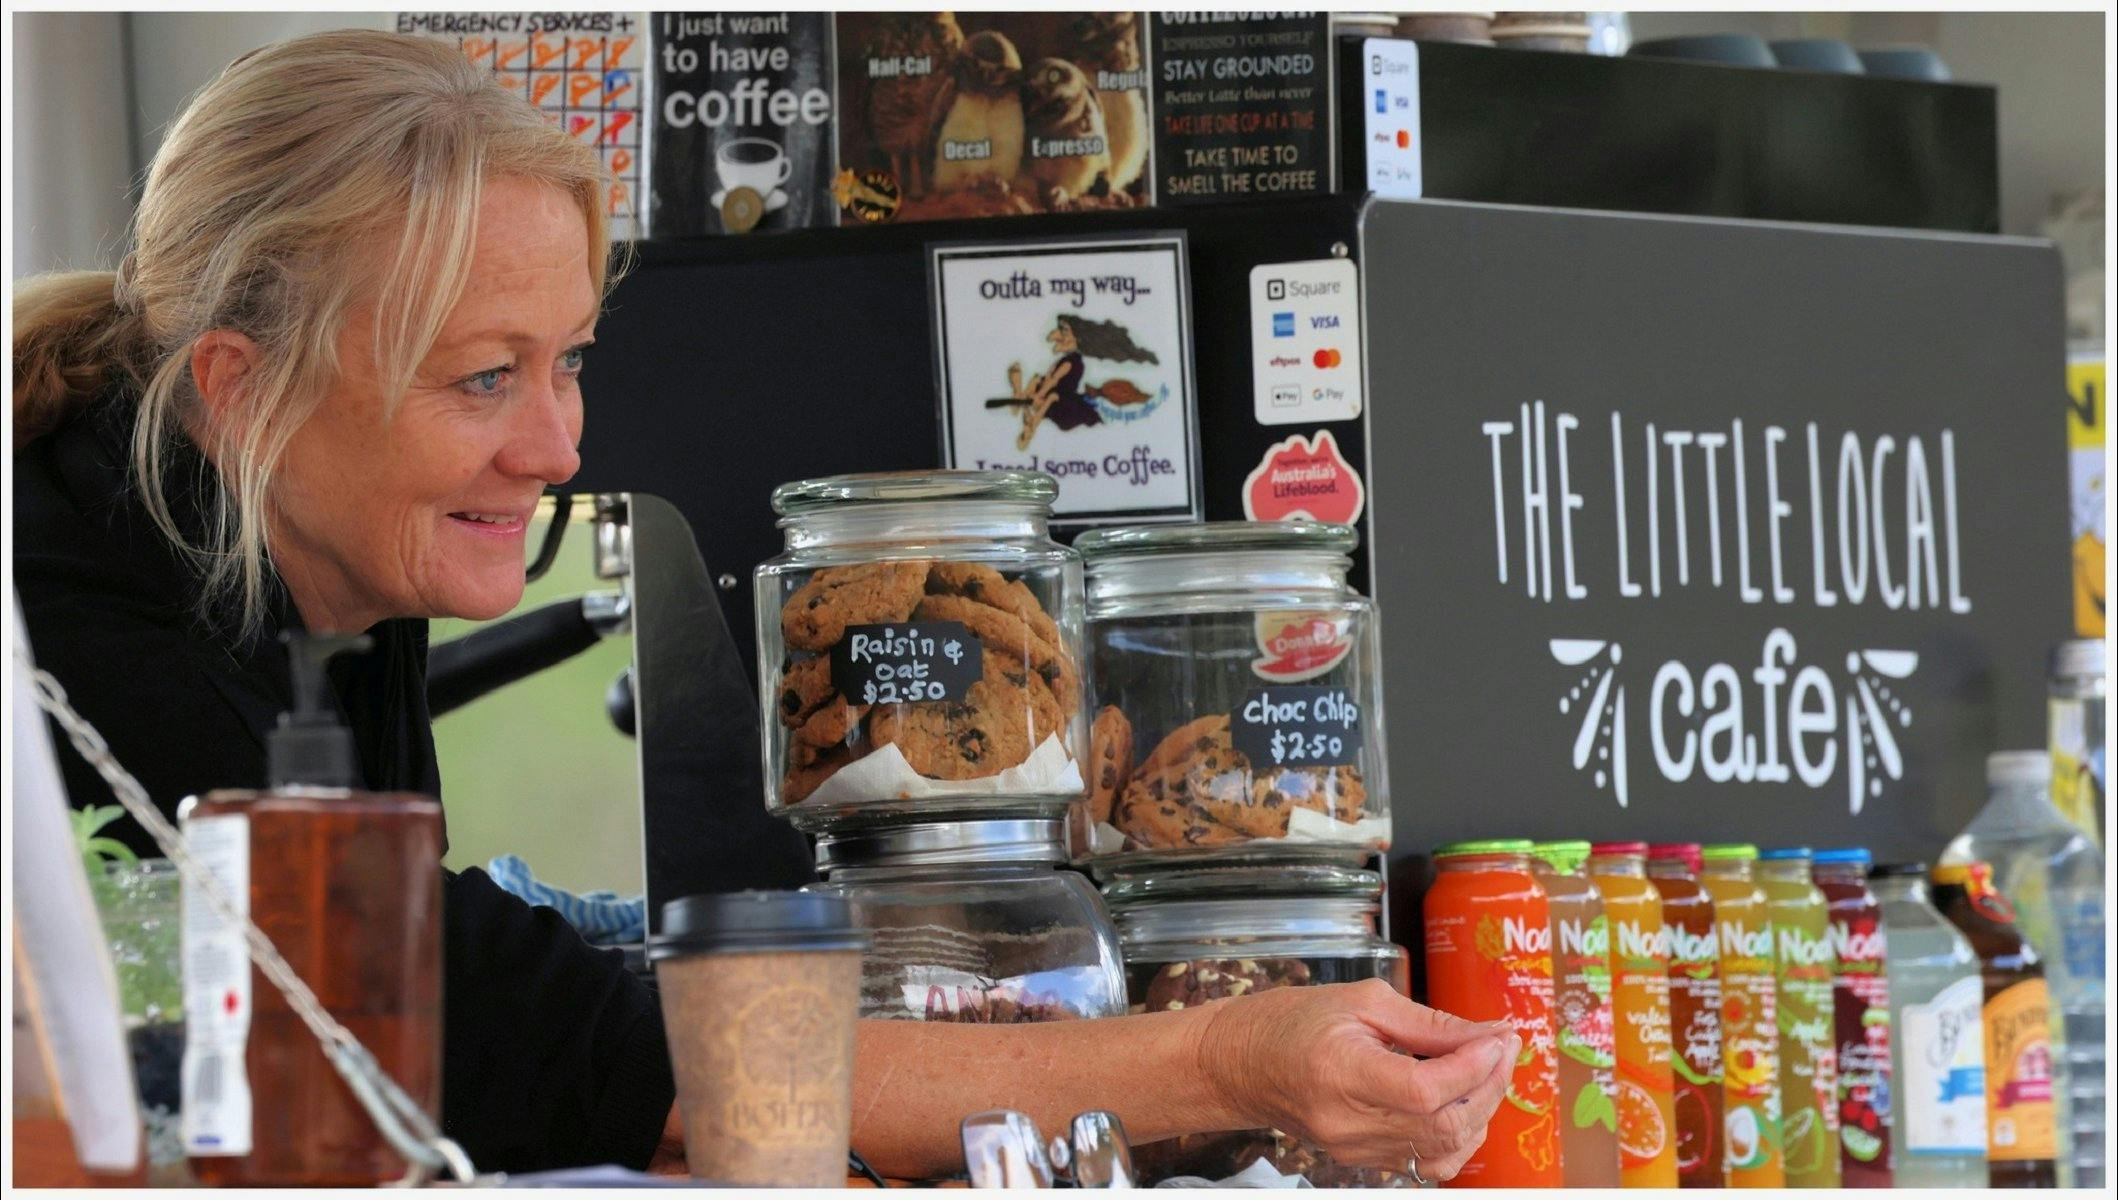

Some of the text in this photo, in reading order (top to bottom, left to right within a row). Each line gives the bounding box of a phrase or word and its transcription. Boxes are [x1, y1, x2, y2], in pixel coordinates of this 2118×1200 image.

[398, 12, 520, 33] EMERGENCY
[526, 11, 612, 33] SERVICES
[677, 12, 724, 40] just
[729, 13, 789, 35] want
[663, 40, 791, 73] to have
[1163, 53, 1315, 82] STAY GROUNDED
[663, 78, 831, 130] coffee
[1185, 144, 1299, 168] TAKE TIME TO
[1167, 170, 1317, 196] SMELL THE COFFEE
[1049, 278, 1085, 307] my
[1289, 280, 1341, 299] Square
[1310, 315, 1341, 330] VISA
[1270, 463, 1337, 484] Australia's
[1481, 399, 1973, 615] THE LITTLE LOCAL
[850, 627, 936, 664] Raisin
[862, 679, 947, 705] $2.50
[1649, 627, 1839, 789] cafe
[1270, 728, 1344, 765] $2.50
